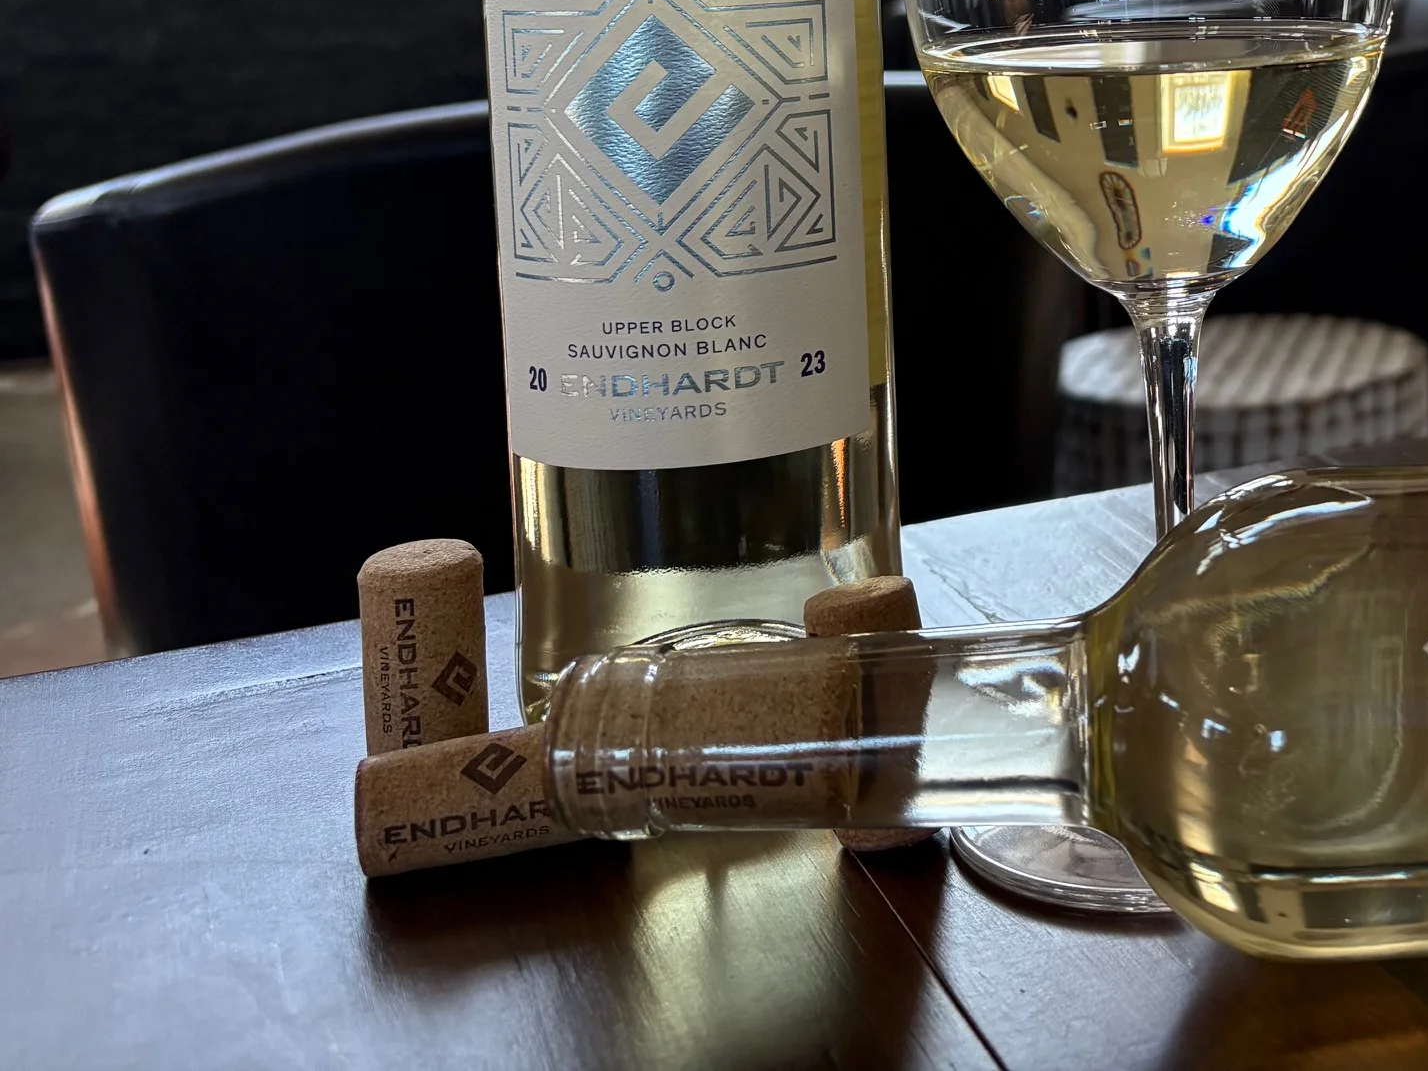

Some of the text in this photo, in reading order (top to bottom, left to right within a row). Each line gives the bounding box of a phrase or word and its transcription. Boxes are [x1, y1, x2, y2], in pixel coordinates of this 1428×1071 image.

[602, 315, 737, 335] UPPER BLOCK
[567, 334, 767, 359] SAUVIGNON BLANC
[528, 350, 826, 398] 20 ENDHARDT 23
[608, 402, 728, 423] VINEYARDS
[379, 646, 393, 733] VINEYARDS
[576, 762, 813, 795] ENDHARDT
[444, 825, 550, 854] VINEYARDS
